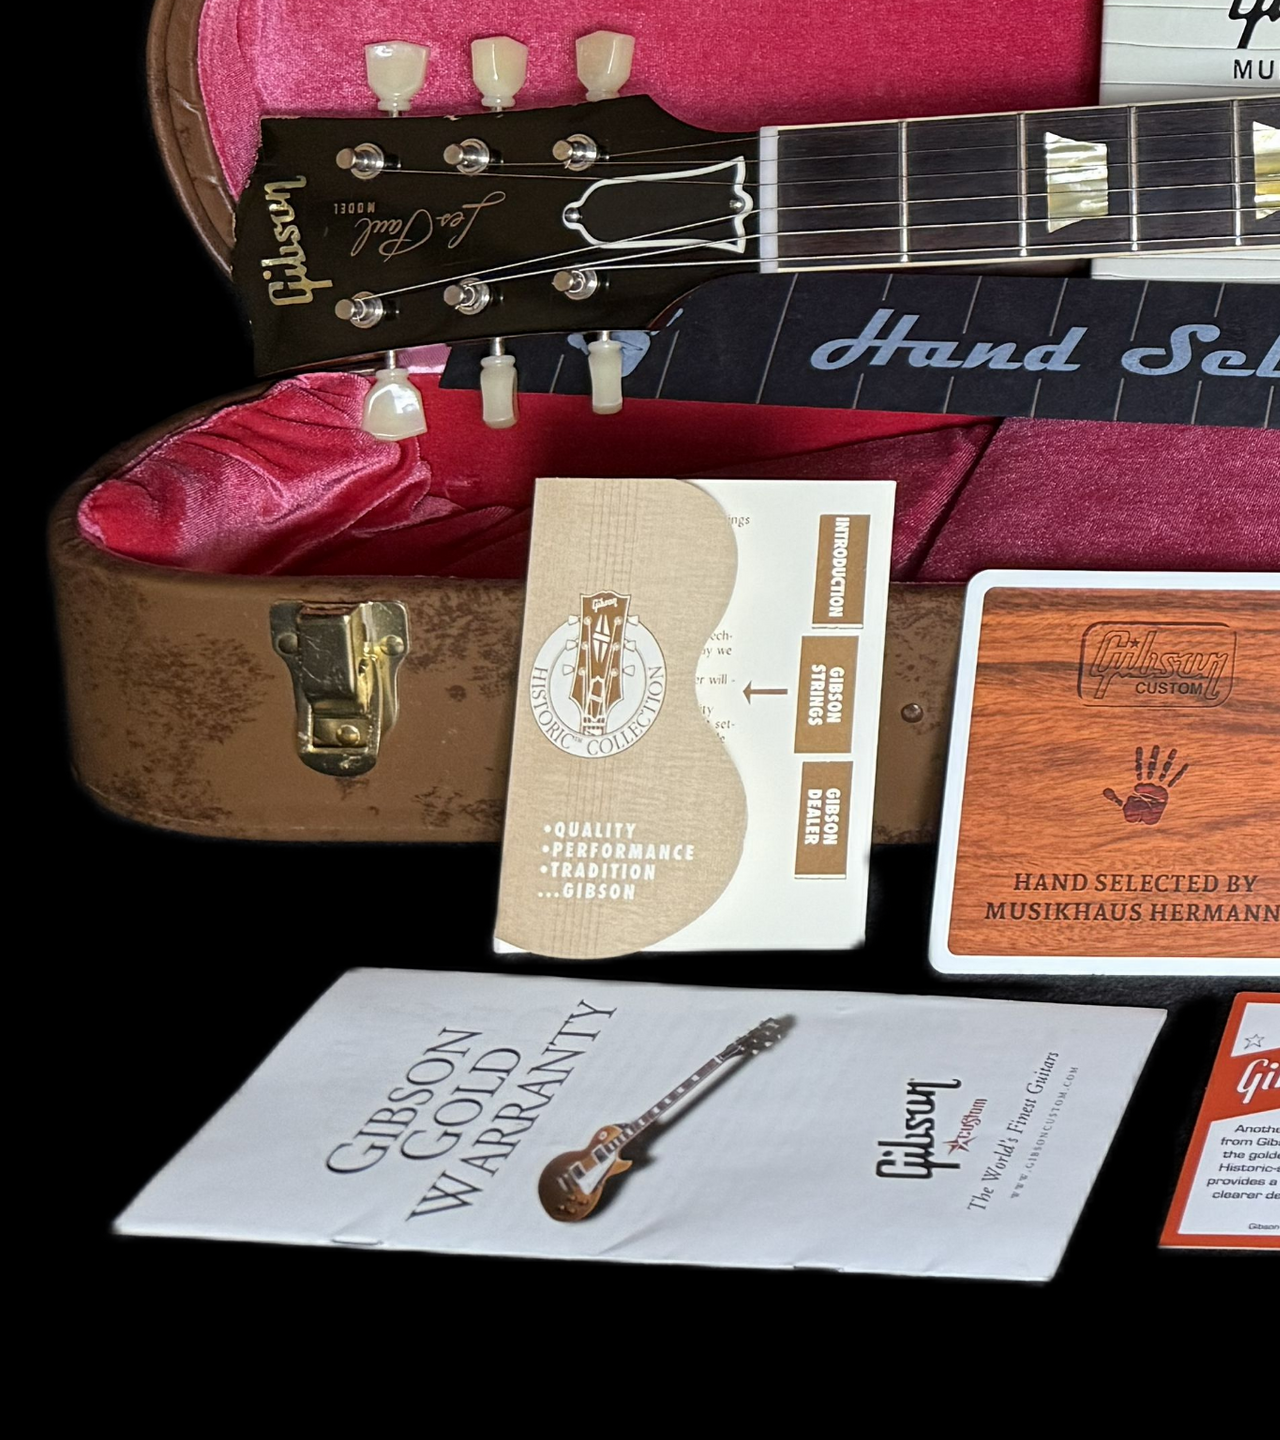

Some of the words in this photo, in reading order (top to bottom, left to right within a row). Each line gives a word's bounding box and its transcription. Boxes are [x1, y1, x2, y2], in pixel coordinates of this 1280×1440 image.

[334, 202, 375, 214] MODEL
[350, 209, 433, 262] Paul
[437, 191, 506, 249] Les
[261, 175, 333, 306] Gibson
[810, 308, 1089, 371] Hand
[829, 516, 850, 618] INTRODUCTION
[592, 598, 618, 613] Gibson
[709, 674, 728, 685] will
[1088, 629, 1229, 701] Gibson
[1135, 682, 1204, 696] CUSTOM
[587, 666, 664, 756] COLLECTION
[808, 664, 827, 726] STRINGS
[826, 666, 845, 724] GIBSON
[804, 788, 823, 845] DEALER
[822, 788, 841, 846] GIBSON
[984, 902, 1142, 922] MUSIKHAUS
[1013, 873, 1088, 892] HAND
[1095, 873, 1220, 893] SELECTED
[1227, 874, 1259, 893] BY
[325, 1027, 483, 1175] GIBSON
[400, 1047, 521, 1160] GOLD
[405, 999, 617, 1221] WARRANTY
[875, 1078, 962, 1180] Gibson
[967, 1186, 994, 1210] The
[981, 1137, 1019, 1182] World's
[1007, 1098, 1037, 1134] Finest
[1026, 1051, 1059, 1094] Guitars
[1220, 1137, 1253, 1146] from
[1223, 1151, 1245, 1159] the
[1206, 1177, 1266, 1187] provides
[1212, 1190, 1263, 1199] clearer
[1248, 1222, 1280, 1230] Gibson
